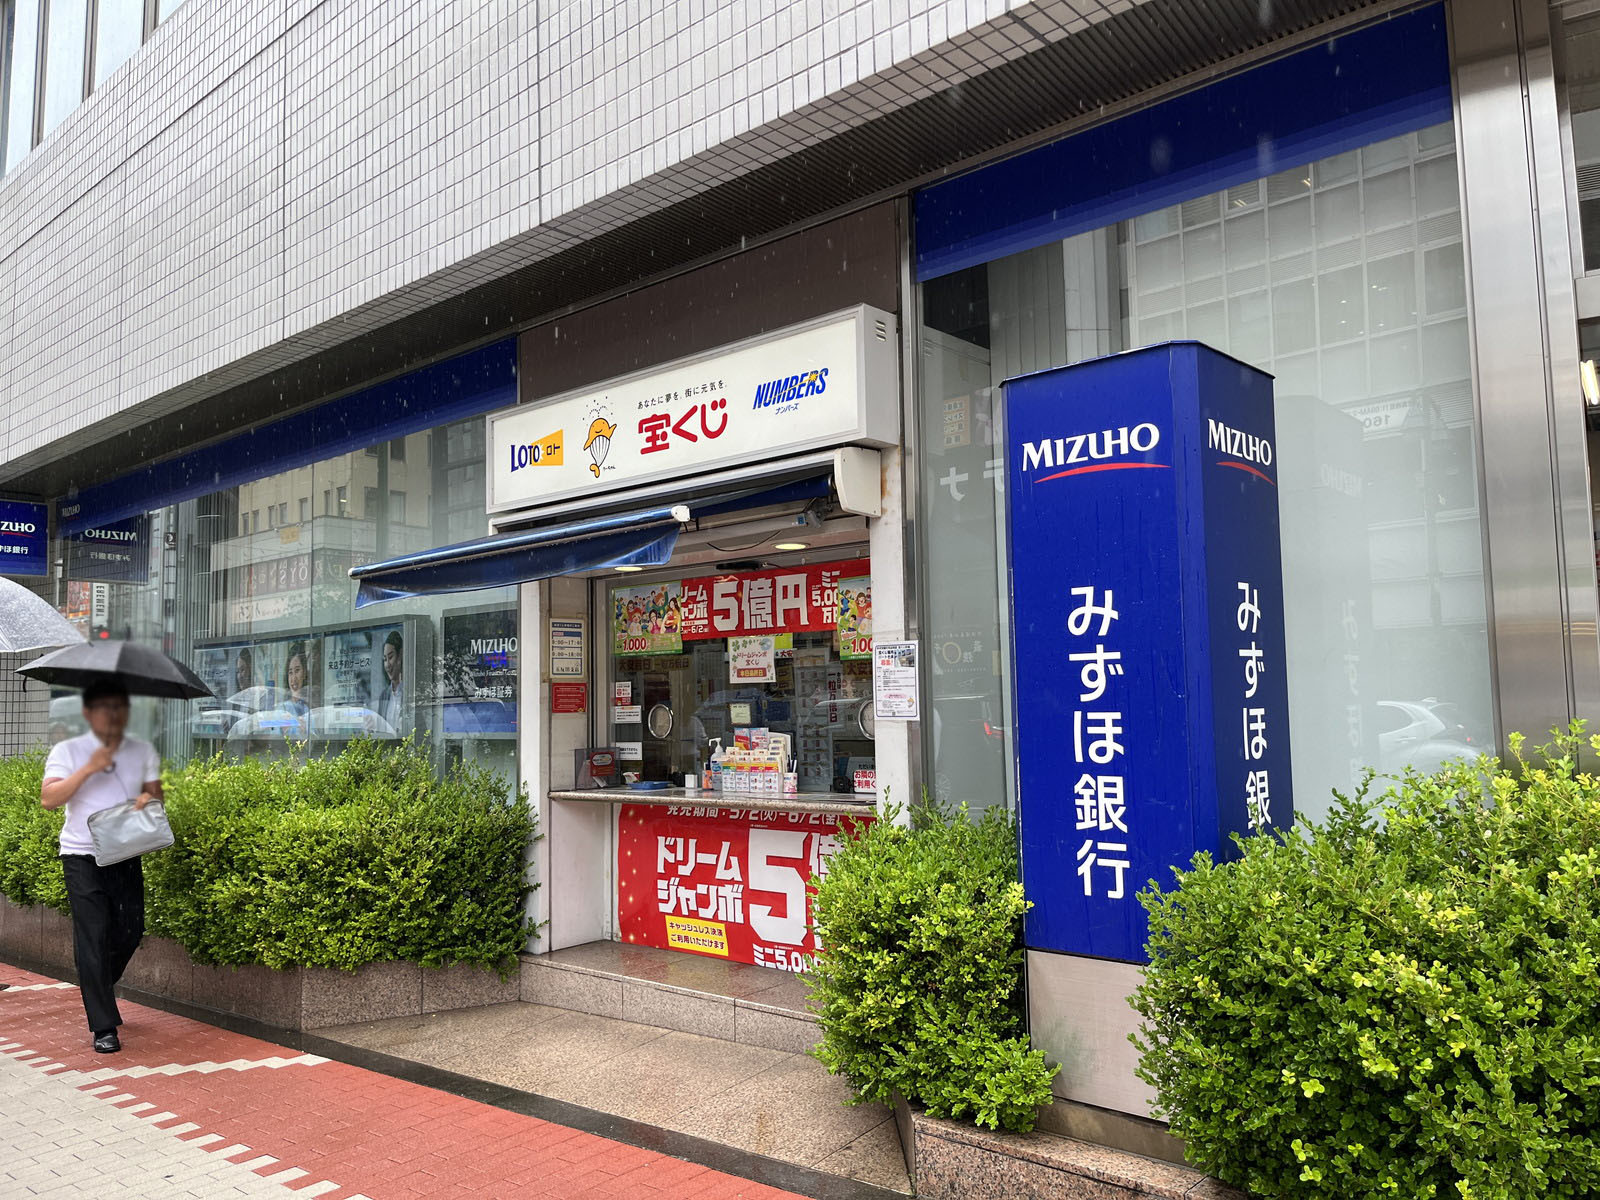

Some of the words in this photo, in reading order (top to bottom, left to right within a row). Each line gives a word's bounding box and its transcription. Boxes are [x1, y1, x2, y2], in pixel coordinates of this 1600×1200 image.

[752, 368, 829, 410] NUMBERS
[638, 398, 728, 455] 宝くじ
[1021, 423, 1160, 471] MIZUHO
[1207, 418, 1272, 467] MIZUHO
[511, 445, 540, 472] LOTO
[713, 573, 809, 632] 5億円
[470, 637, 519, 656] MIZUHO
[1236, 581, 1273, 829] みずほ銀
[1067, 586, 1131, 900] みずほ銀行
[657, 836, 742, 882] ドリーム
[657, 878, 744, 924] ジャンボ
[669, 921, 724, 937] キャッシュレス決済
[671, 933, 725, 950] ご利用いただけます
